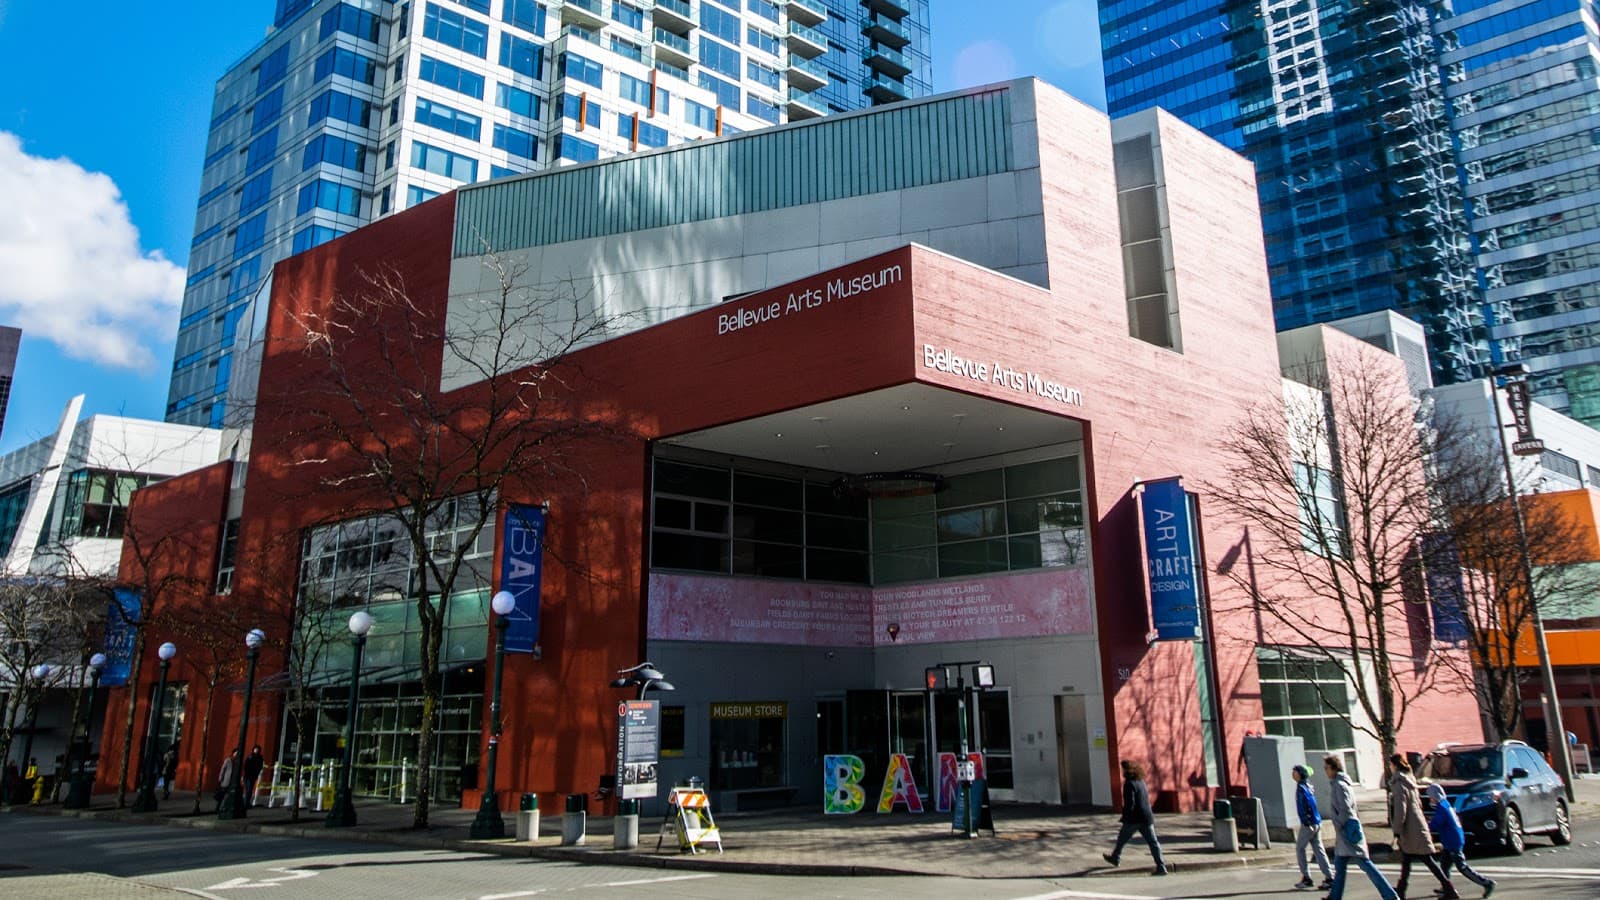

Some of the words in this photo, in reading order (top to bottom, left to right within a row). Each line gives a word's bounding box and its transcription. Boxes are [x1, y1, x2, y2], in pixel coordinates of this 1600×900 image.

[718, 301, 780, 335] Bellevue
[785, 288, 822, 315] Arts
[827, 264, 901, 302] Museum
[923, 343, 988, 381] Bellevue
[992, 361, 1023, 390] Arts
[1026, 371, 1082, 406] Museum
[1514, 440, 1543, 451] TAVERN
[1154, 508, 1179, 555] ART
[506, 527, 538, 621] BAM
[1150, 556, 1190, 577] CRAFT
[820, 591, 834, 601] YOU
[874, 592, 895, 602] YOUR
[895, 587, 941, 601] WOODLANDS
[942, 584, 984, 596] WETLANDS
[1151, 579, 1190, 592] DESIGN
[911, 600, 927, 609] AND
[928, 597, 964, 608] TUNNELS
[965, 594, 992, 604] BERRY
[767, 609, 792, 618] FIELDS
[903, 608, 936, 621] BIOTECH
[937, 606, 979, 617] DREAMERS
[980, 603, 1015, 614] FERTILE
[909, 621, 931, 632] YOUR
[932, 618, 963, 629] BEAUTY
[964, 618, 975, 627] AT
[1016, 613, 1026, 623] 12
[916, 631, 936, 641] VIEW
[713, 705, 752, 717] MUSEUM
[754, 705, 783, 716] STORE
[617, 726, 625, 787] INFORMATION
[824, 752, 984, 814] BAM
